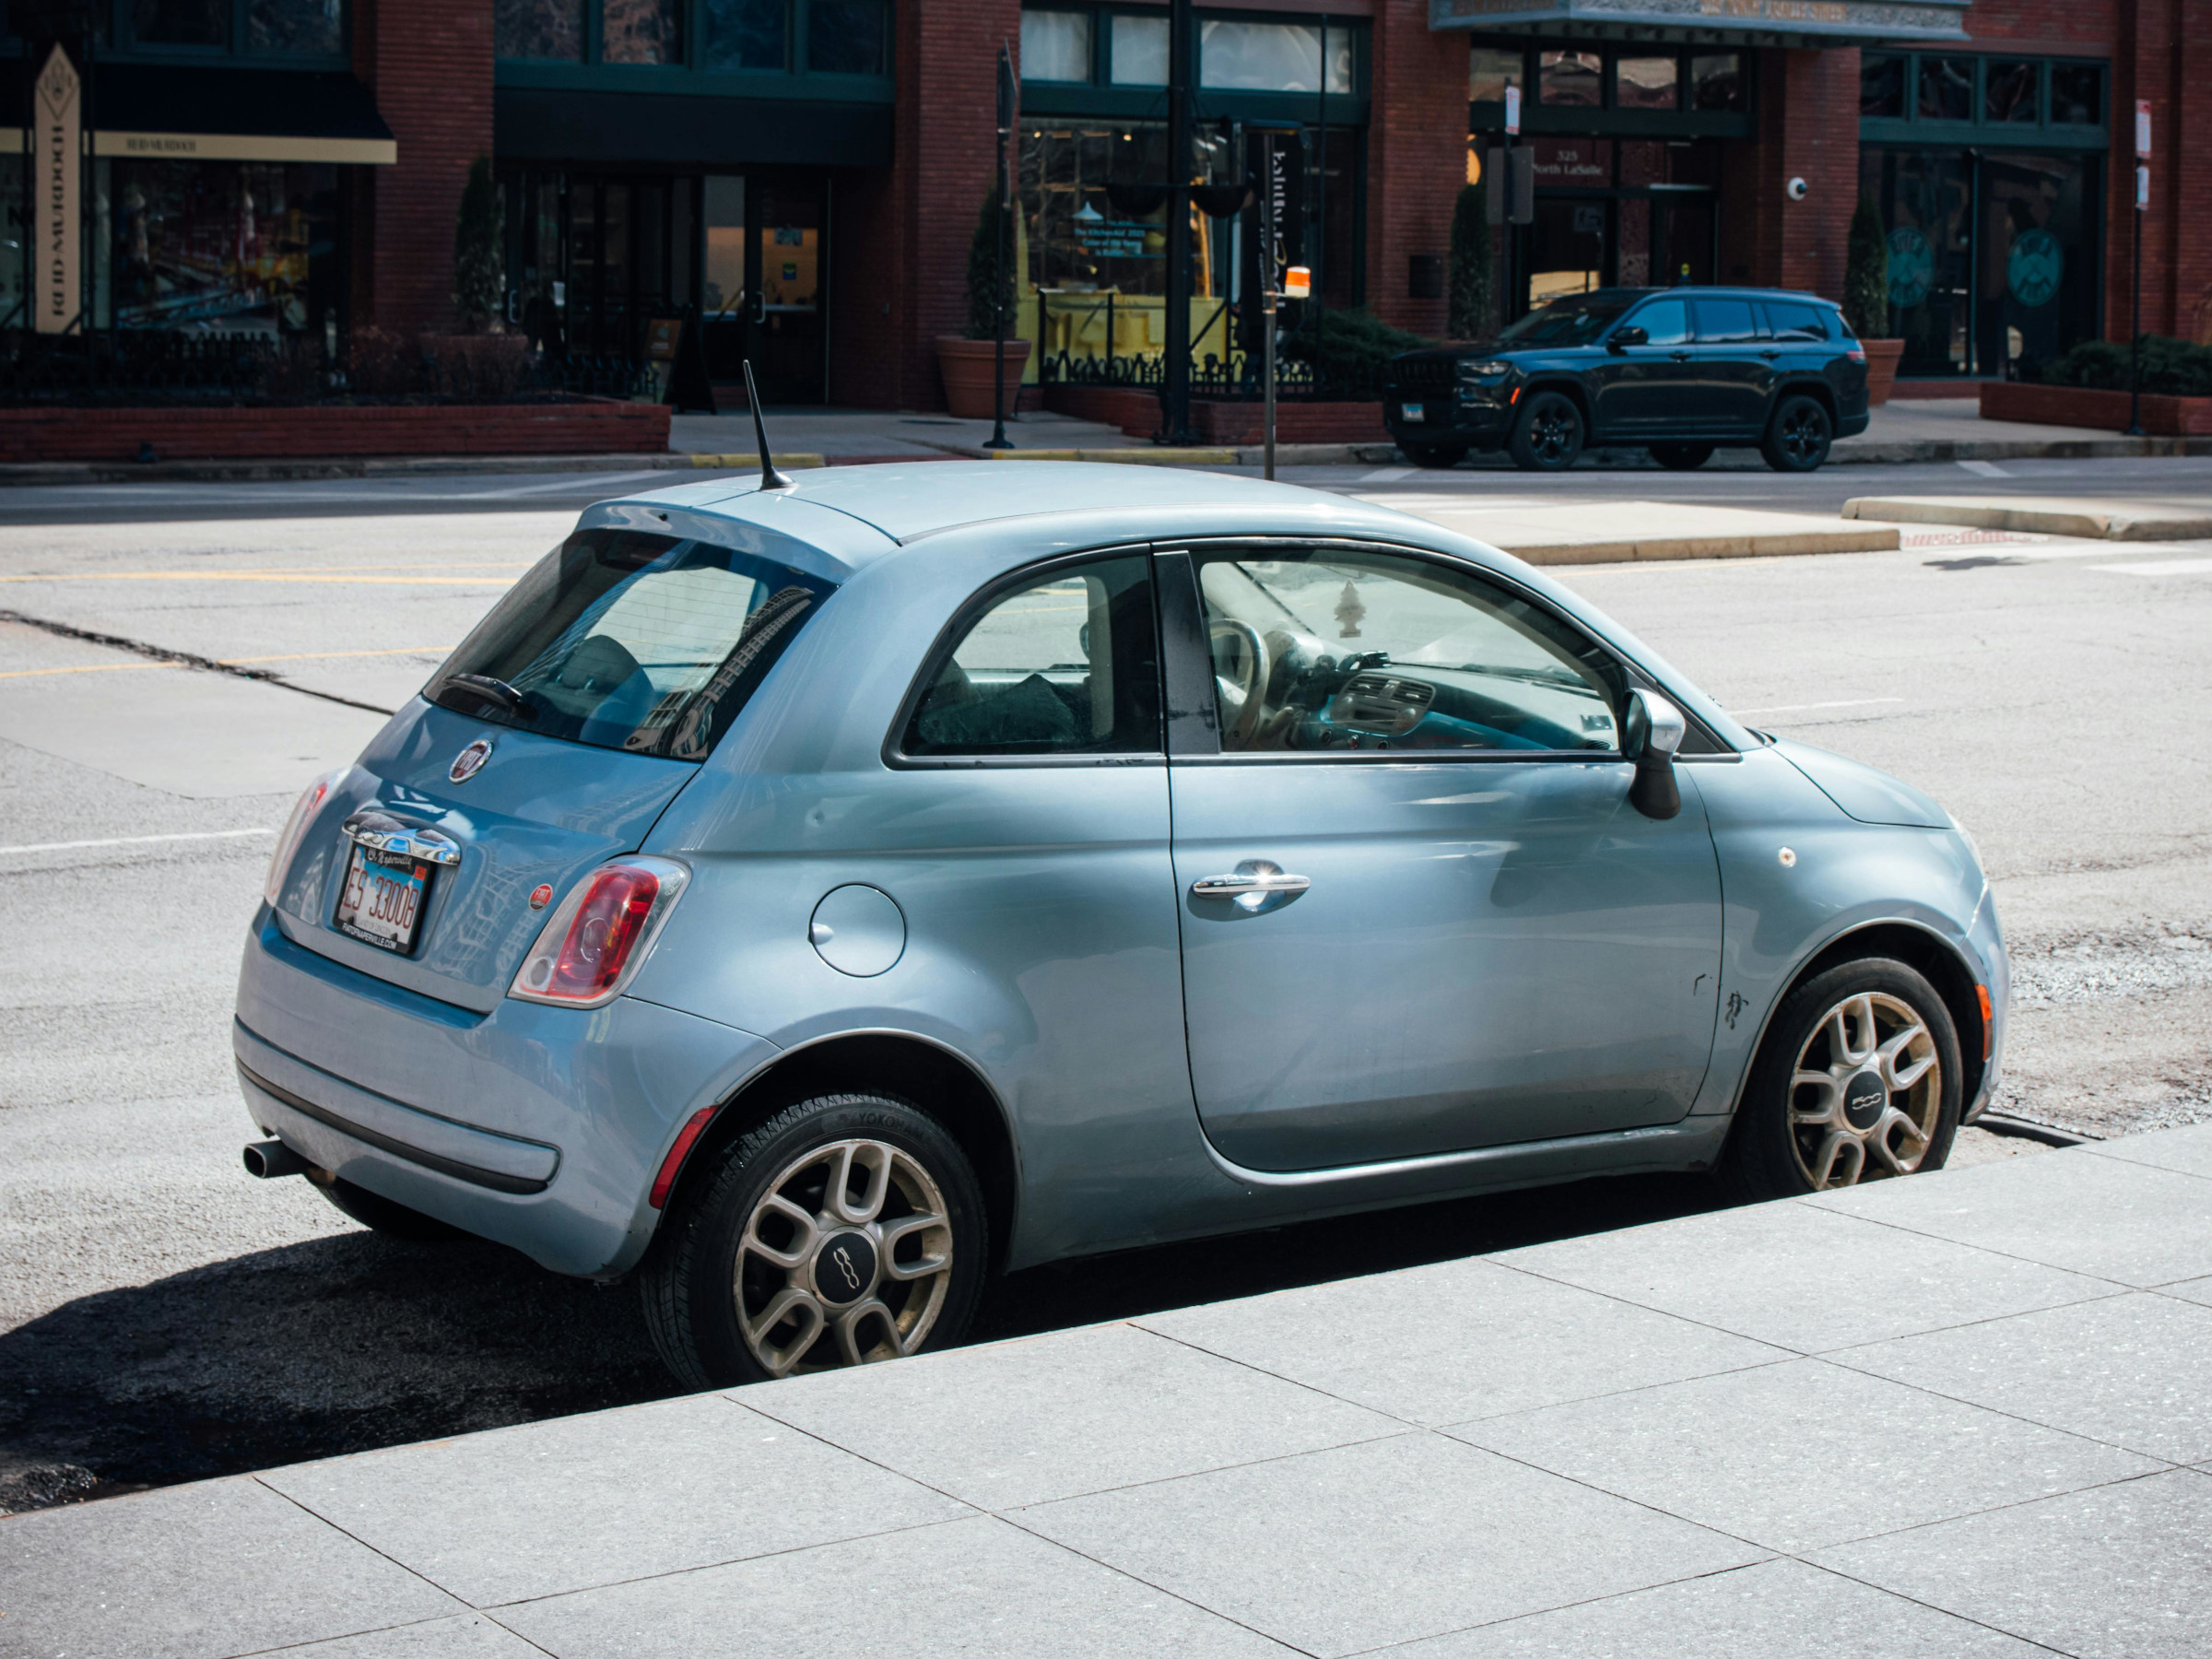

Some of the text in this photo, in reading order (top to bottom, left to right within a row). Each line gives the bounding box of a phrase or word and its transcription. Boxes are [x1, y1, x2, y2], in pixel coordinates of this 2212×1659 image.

[455, 749, 483, 771] FIAT
[343, 866, 419, 930] ES 33008
[535, 888, 551, 902] FIAT
[1852, 1092, 1882, 1111] 500
[832, 1246, 860, 1289] 500
